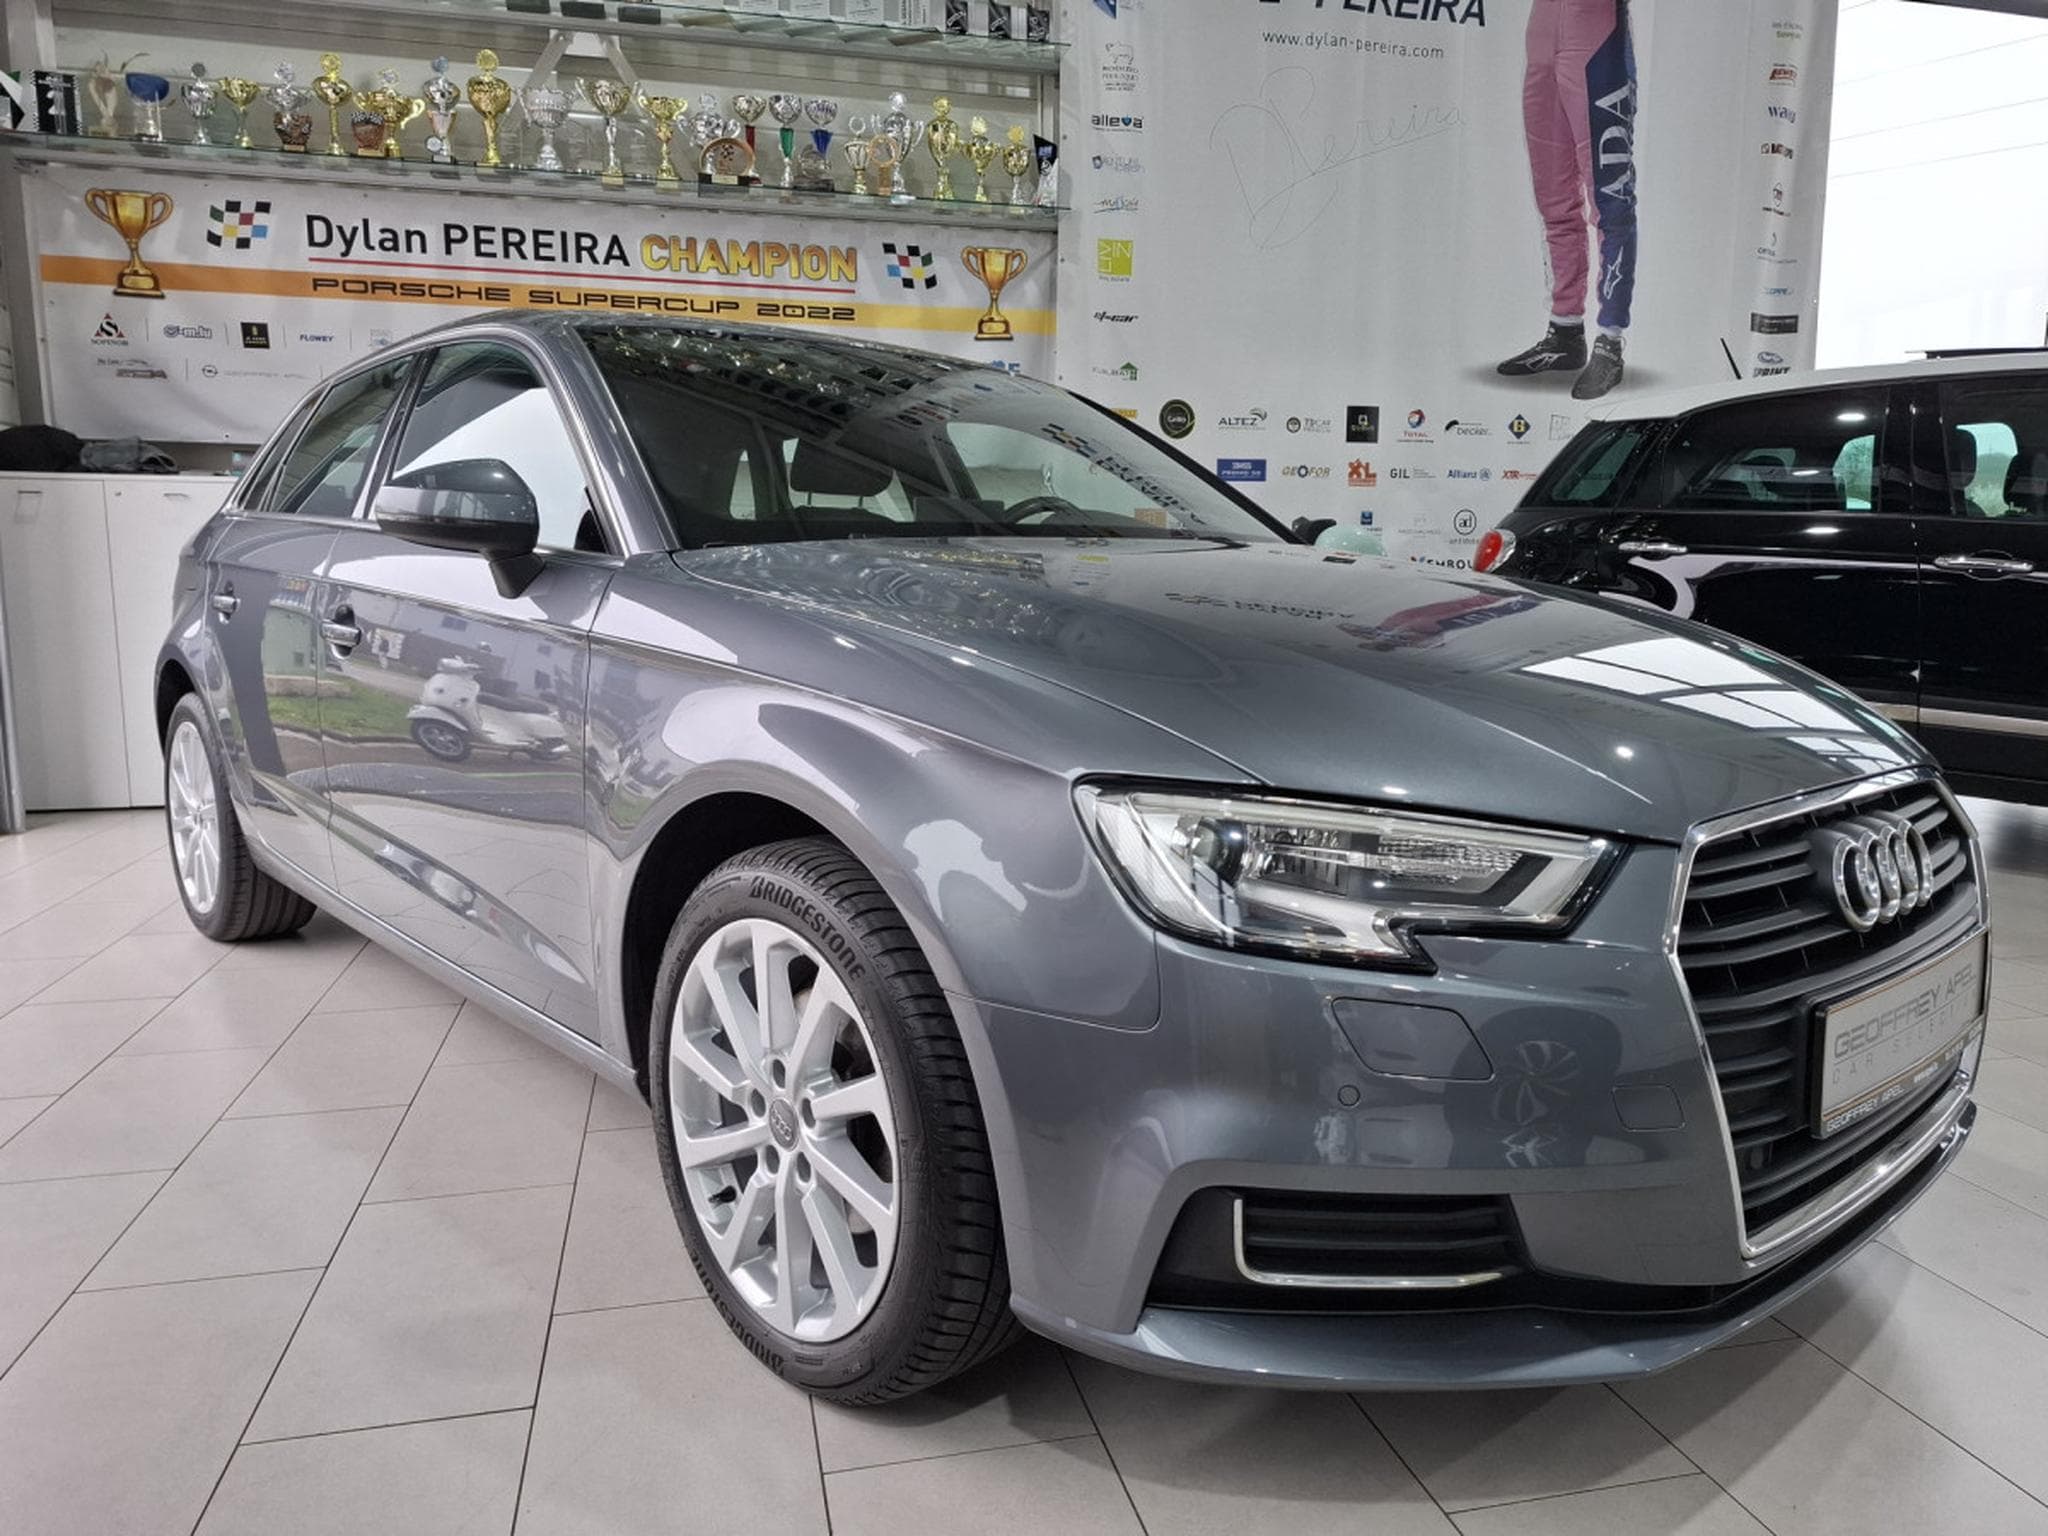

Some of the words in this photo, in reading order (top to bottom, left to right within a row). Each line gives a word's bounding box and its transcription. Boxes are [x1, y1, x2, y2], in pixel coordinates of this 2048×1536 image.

[1261, 31, 1444, 59] www.dylan-pereira.com
[305, 214, 428, 258] Dylan
[443, 223, 630, 267] PEREIRA
[640, 233, 858, 282] CHAMPION
[312, 277, 510, 302] PORSCHE
[529, 290, 740, 314] SUPERCUP
[757, 302, 856, 321] 2022
[1447, 469, 1478, 479] Allianz
[749, 875, 867, 981] BRIDGESTONE
[1833, 984, 1941, 1059] GEOFFREY
